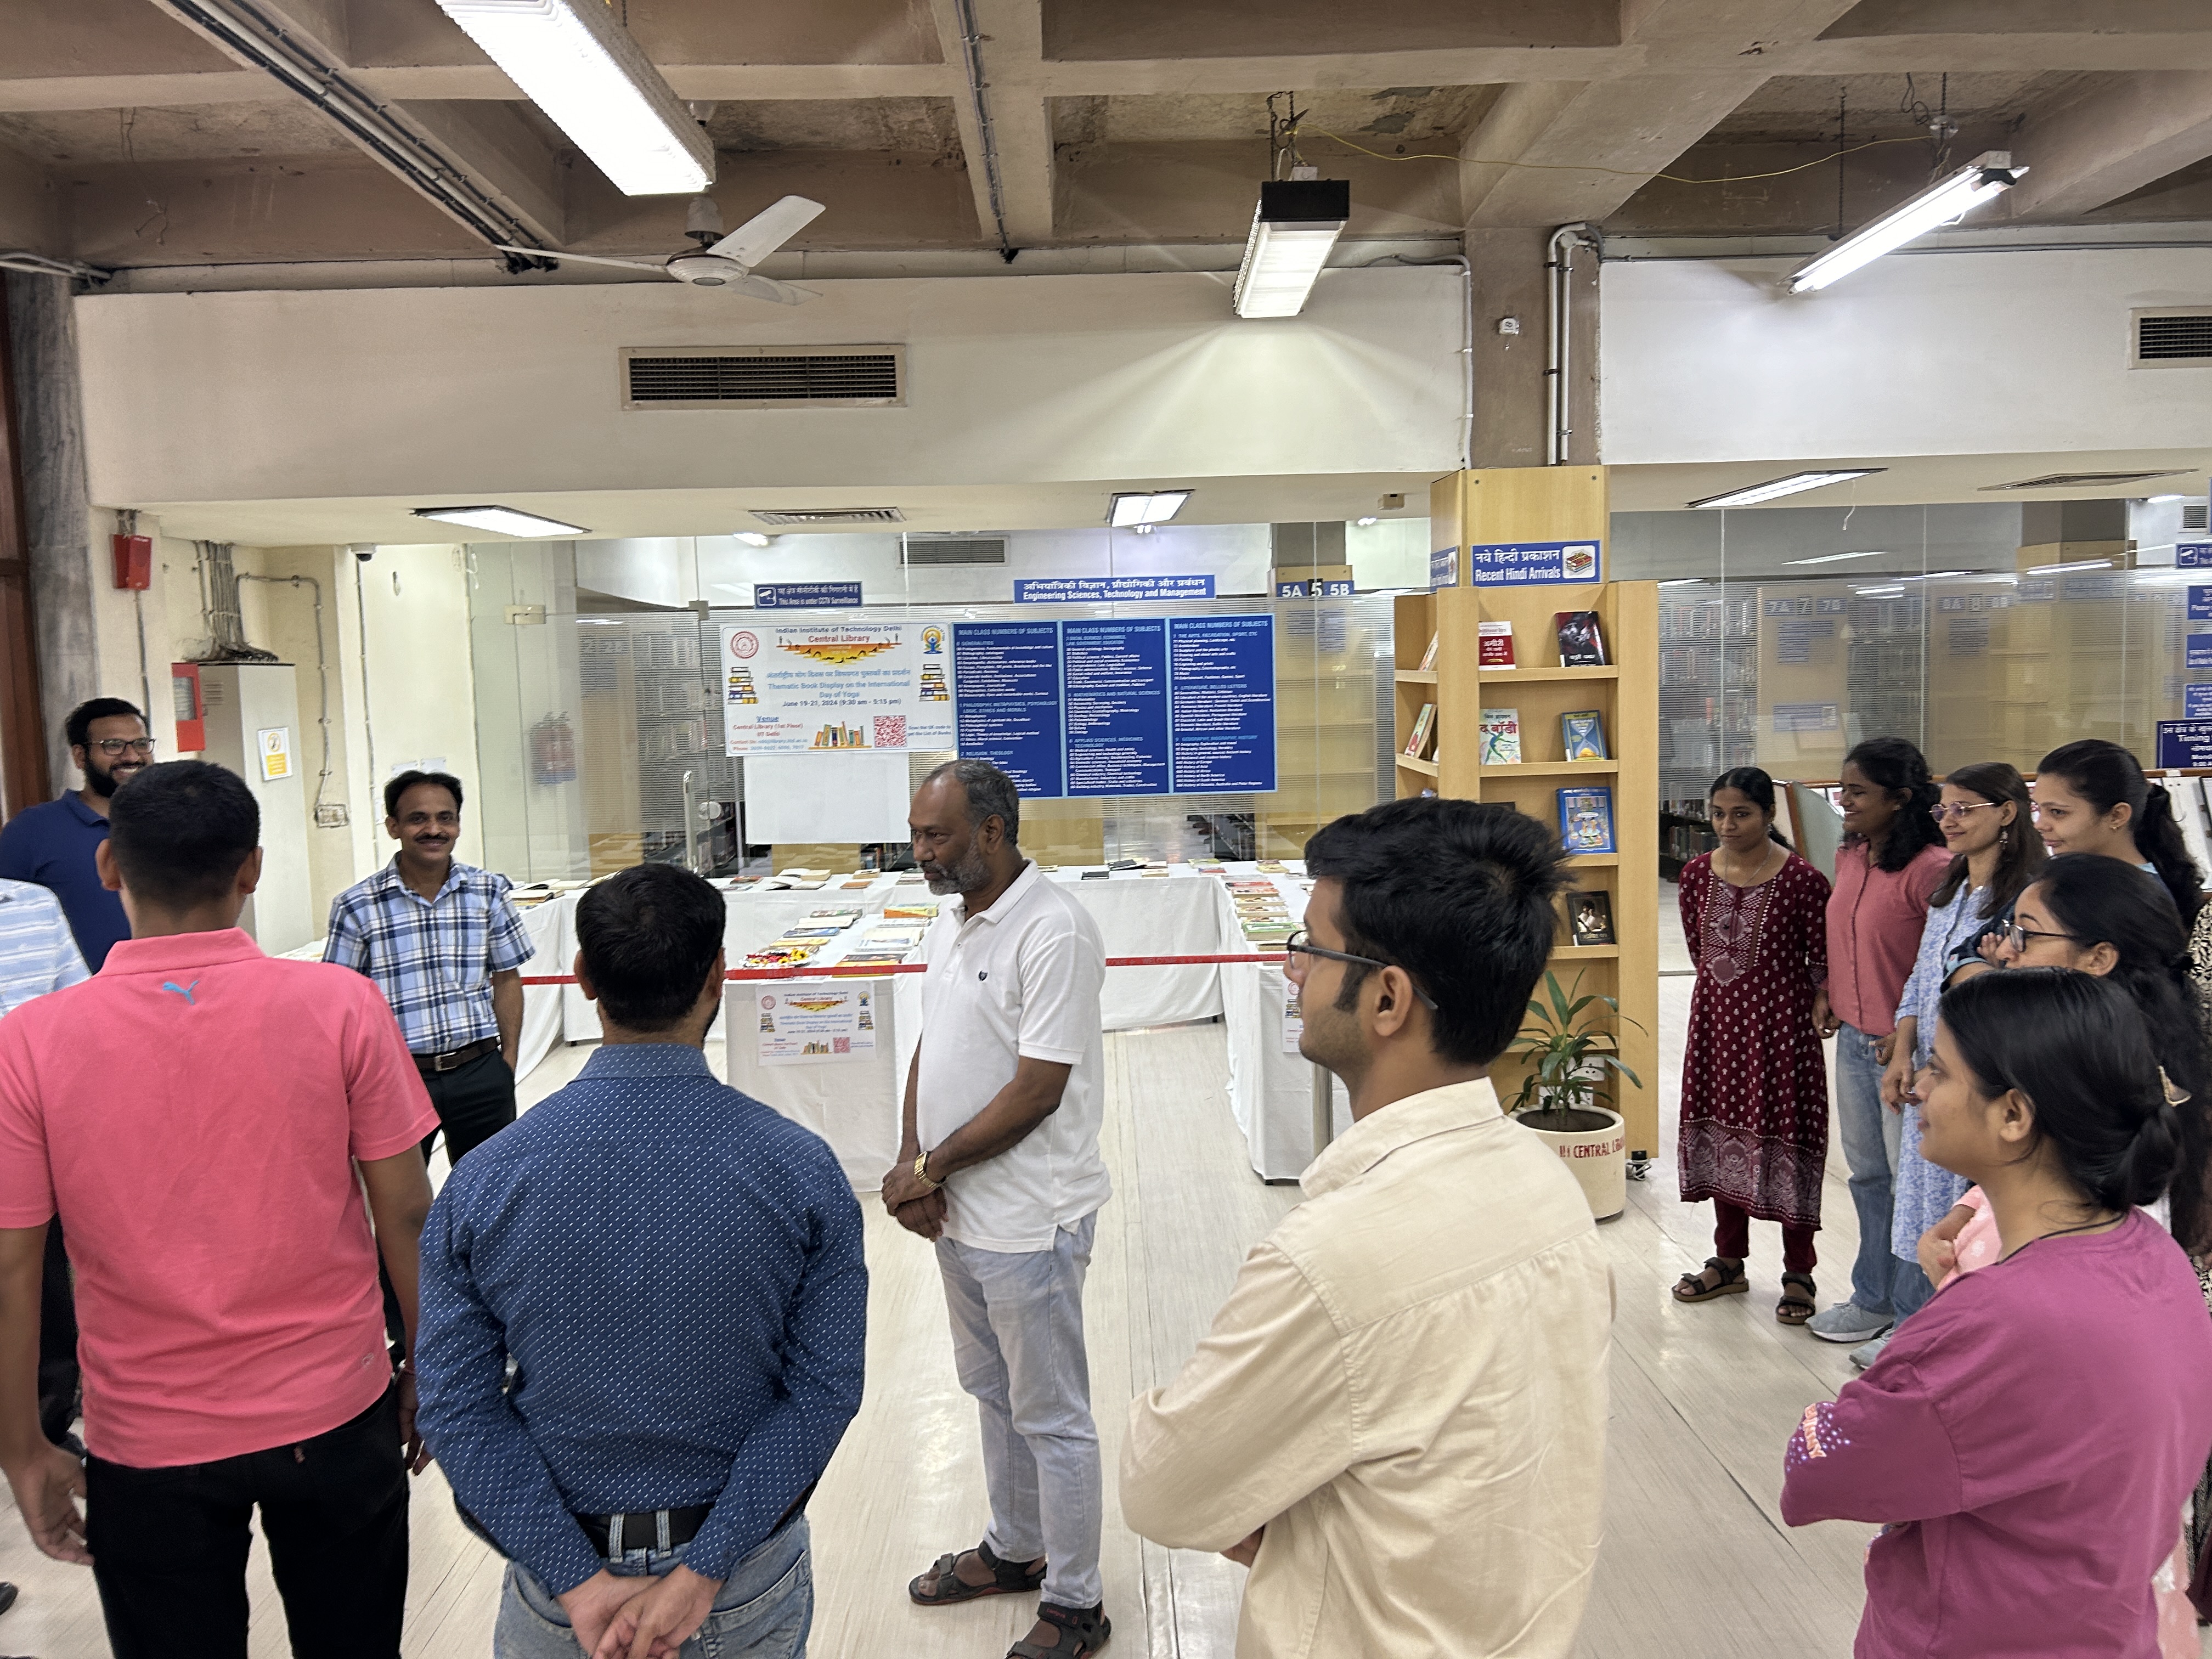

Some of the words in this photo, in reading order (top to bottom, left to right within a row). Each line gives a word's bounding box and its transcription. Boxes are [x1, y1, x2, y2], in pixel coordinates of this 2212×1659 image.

[1493, 548, 1519, 564] हिन्दी
[1520, 550, 1560, 562] प्रकाशन
[1475, 568, 1504, 582] Recent
[1505, 567, 1527, 580] Hindi
[1528, 566, 1561, 579] Arrivals
[1158, 579, 1175, 588] और
[1311, 582, 1323, 597] 5
[1330, 583, 1350, 596] 5B
[1023, 591, 1066, 601] Engineering
[1067, 590, 1102, 600] Sciences,
[1104, 589, 1144, 599] Technology
[1145, 589, 1159, 597] and
[1160, 588, 1206, 597] Management
[1282, 585, 1303, 597] 5A
[1799, 598, 1810, 614] 7
[841, 635, 870, 643] Library
[1491, 721, 1517, 733] बॉडी
[2177, 734, 2210, 743] Timing
[1573, 1142, 1610, 1158] CENTRAL
